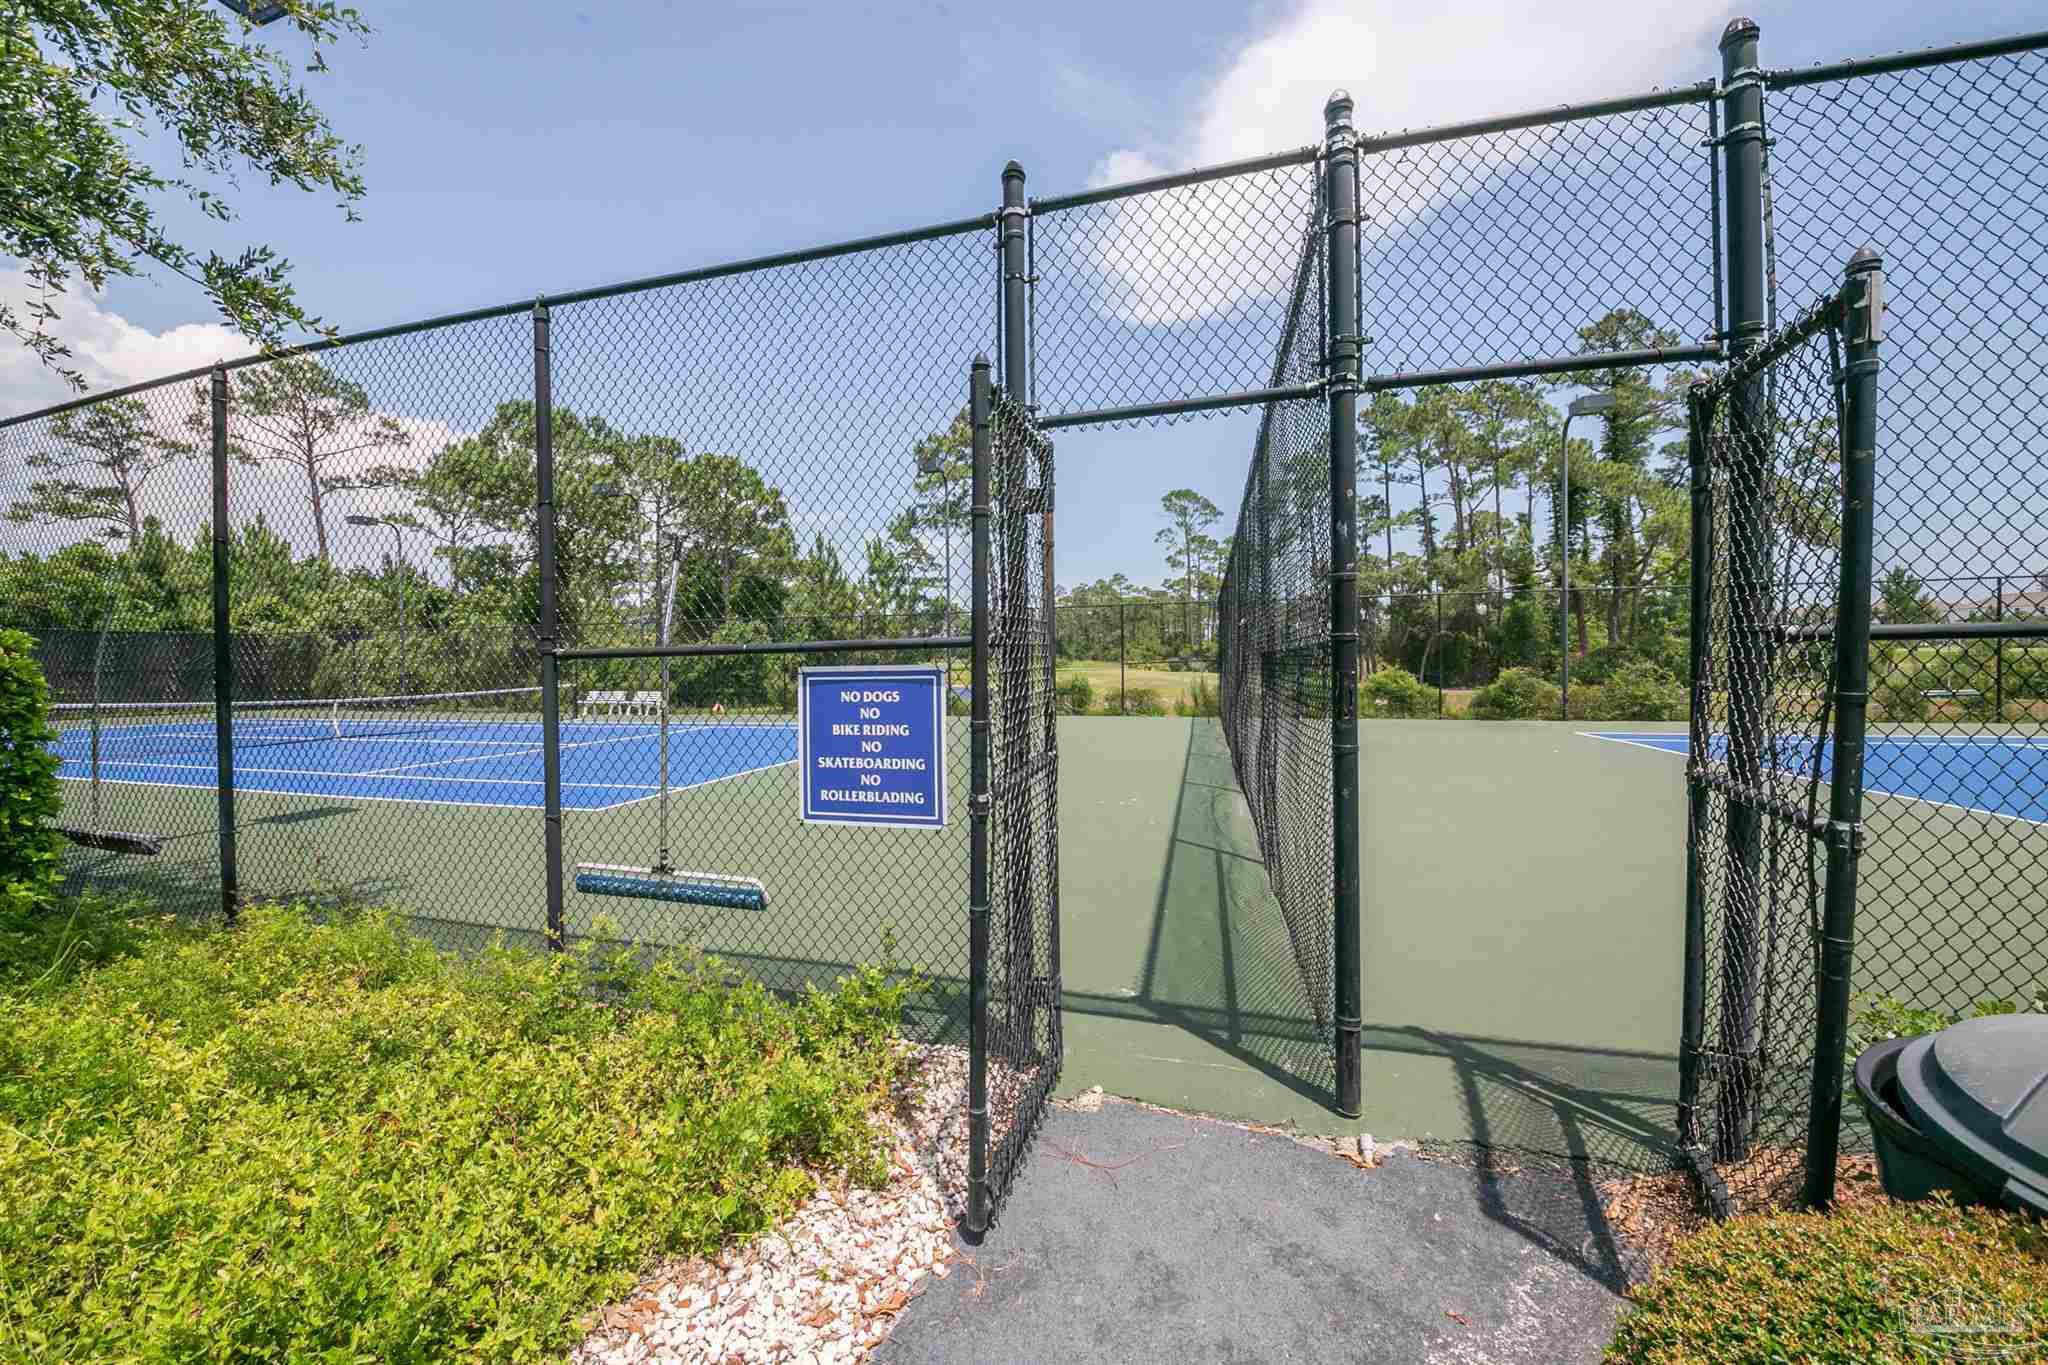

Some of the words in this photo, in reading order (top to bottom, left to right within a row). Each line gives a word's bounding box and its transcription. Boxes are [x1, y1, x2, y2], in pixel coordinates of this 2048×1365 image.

[840, 691, 861, 702] NO
[863, 690, 900, 702] DOGS
[859, 707, 880, 719] NO
[832, 724, 861, 736] BIKE
[863, 724, 910, 736] RIDING
[861, 741, 882, 752] NO
[817, 757, 926, 770] SKATEBOARDING
[860, 774, 881, 785] NO
[820, 790, 924, 804] ROLLERBLADING
